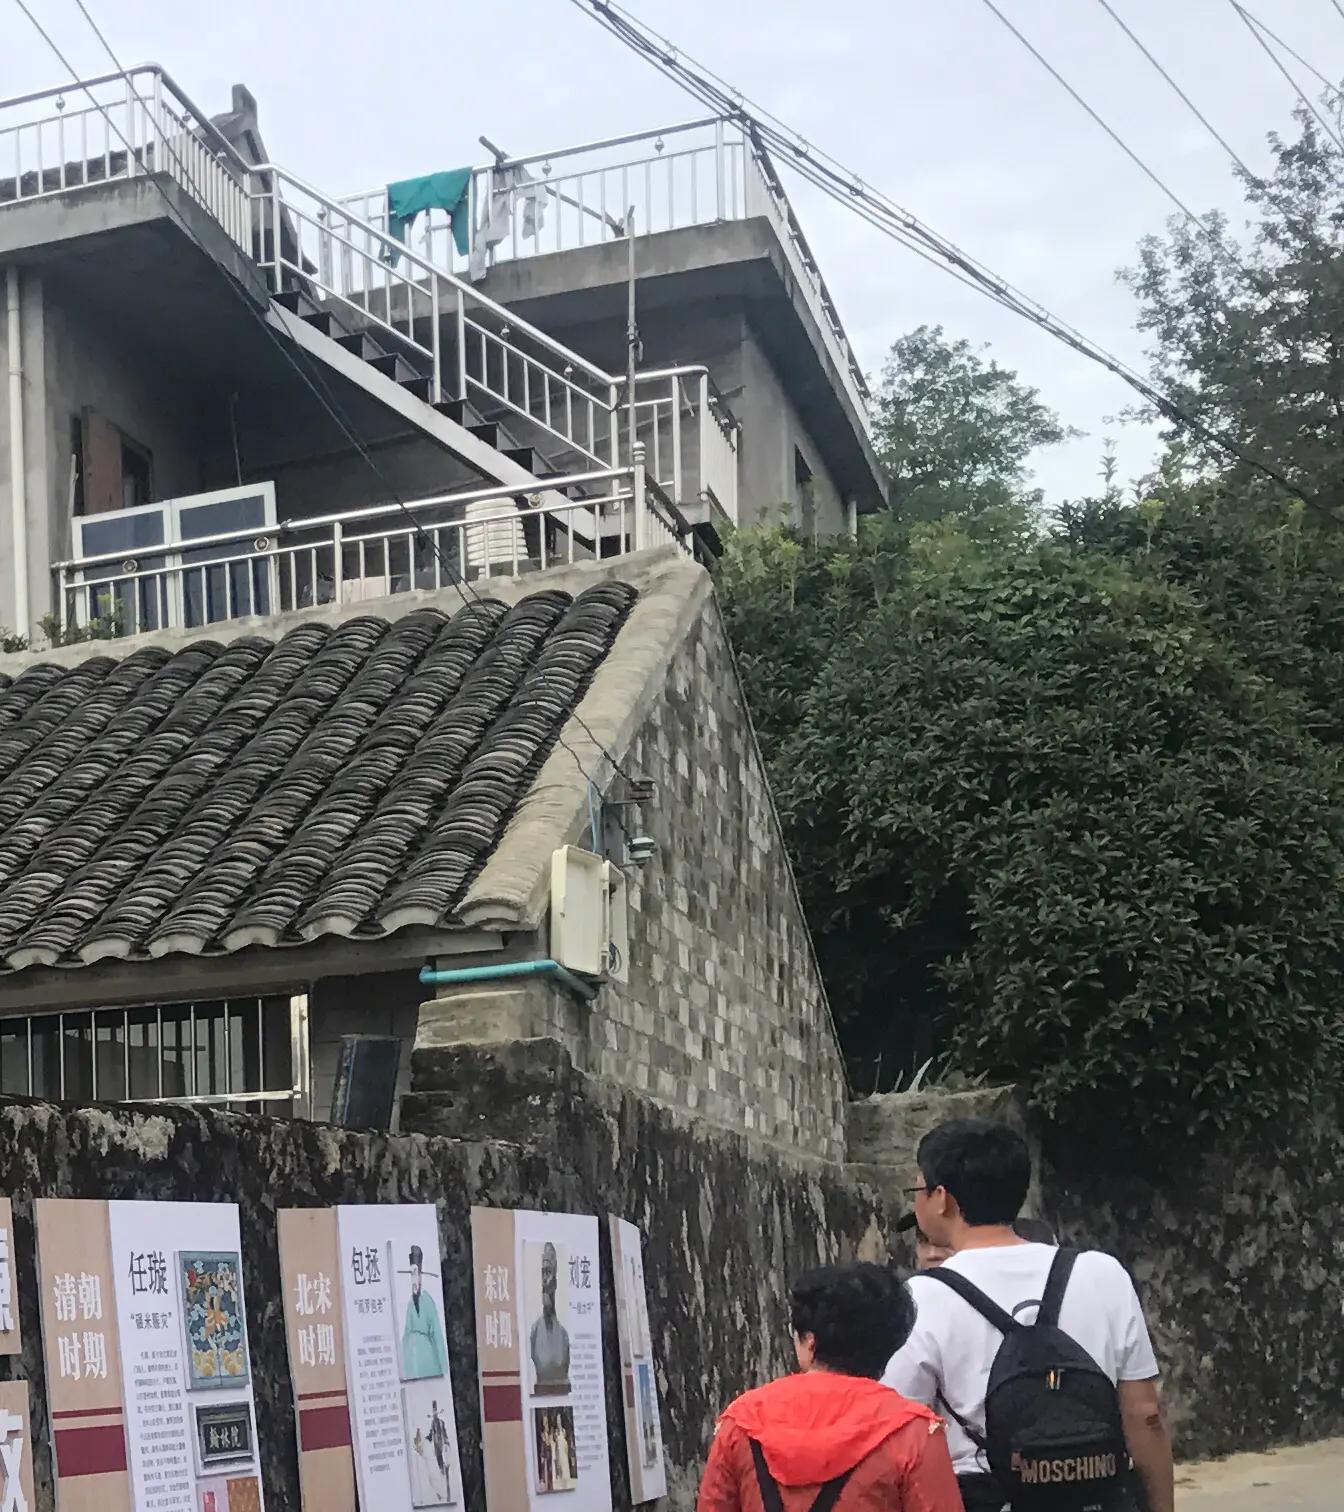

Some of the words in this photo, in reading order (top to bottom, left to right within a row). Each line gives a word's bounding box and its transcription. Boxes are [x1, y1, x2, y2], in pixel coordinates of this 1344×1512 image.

[352, 1246, 381, 1285] 包拯
[482, 1263, 511, 1302] 东汉
[53, 1271, 104, 1322] 清朝
[293, 1272, 333, 1317] 北宋
[297, 1324, 336, 1368] 时期
[484, 1310, 512, 1349] 时期
[58, 1331, 109, 1381] 时期
[1020, 1452, 1117, 1483] MOSCHINO
